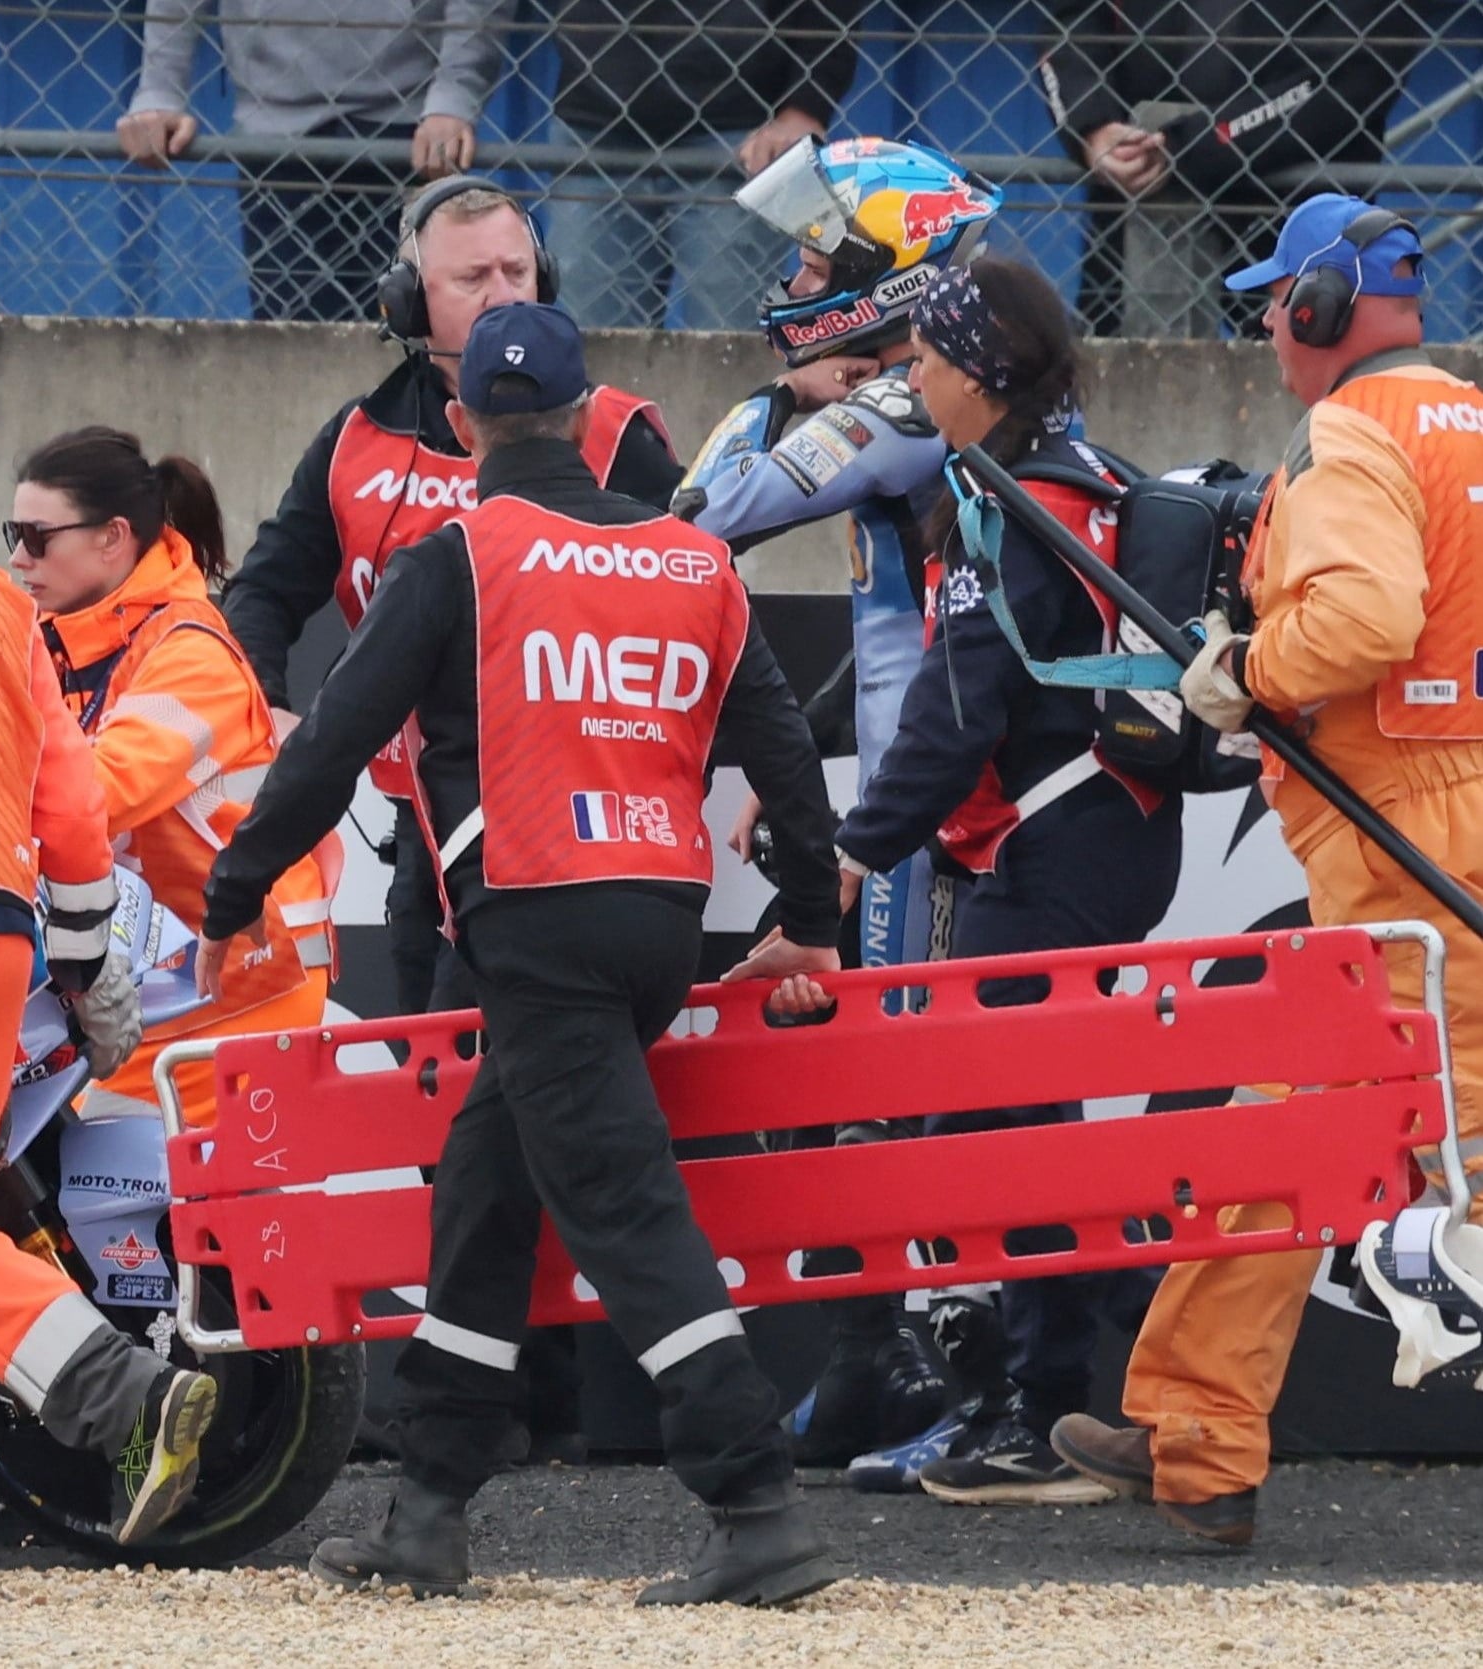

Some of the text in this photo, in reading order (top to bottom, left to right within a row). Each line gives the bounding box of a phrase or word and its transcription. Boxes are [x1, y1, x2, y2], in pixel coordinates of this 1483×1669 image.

[881, 269, 932, 301] SHOEI
[781, 297, 881, 346] Red Bull
[354, 468, 479, 512] Moto
[518, 538, 719, 584] MotoGP
[523, 629, 710, 713] MED
[581, 716, 668, 743] MEDICAL
[866, 871, 894, 952] NEW
[67, 1175, 167, 1195] MOTO-TRON
[115, 1284, 165, 1299] SIPEX
